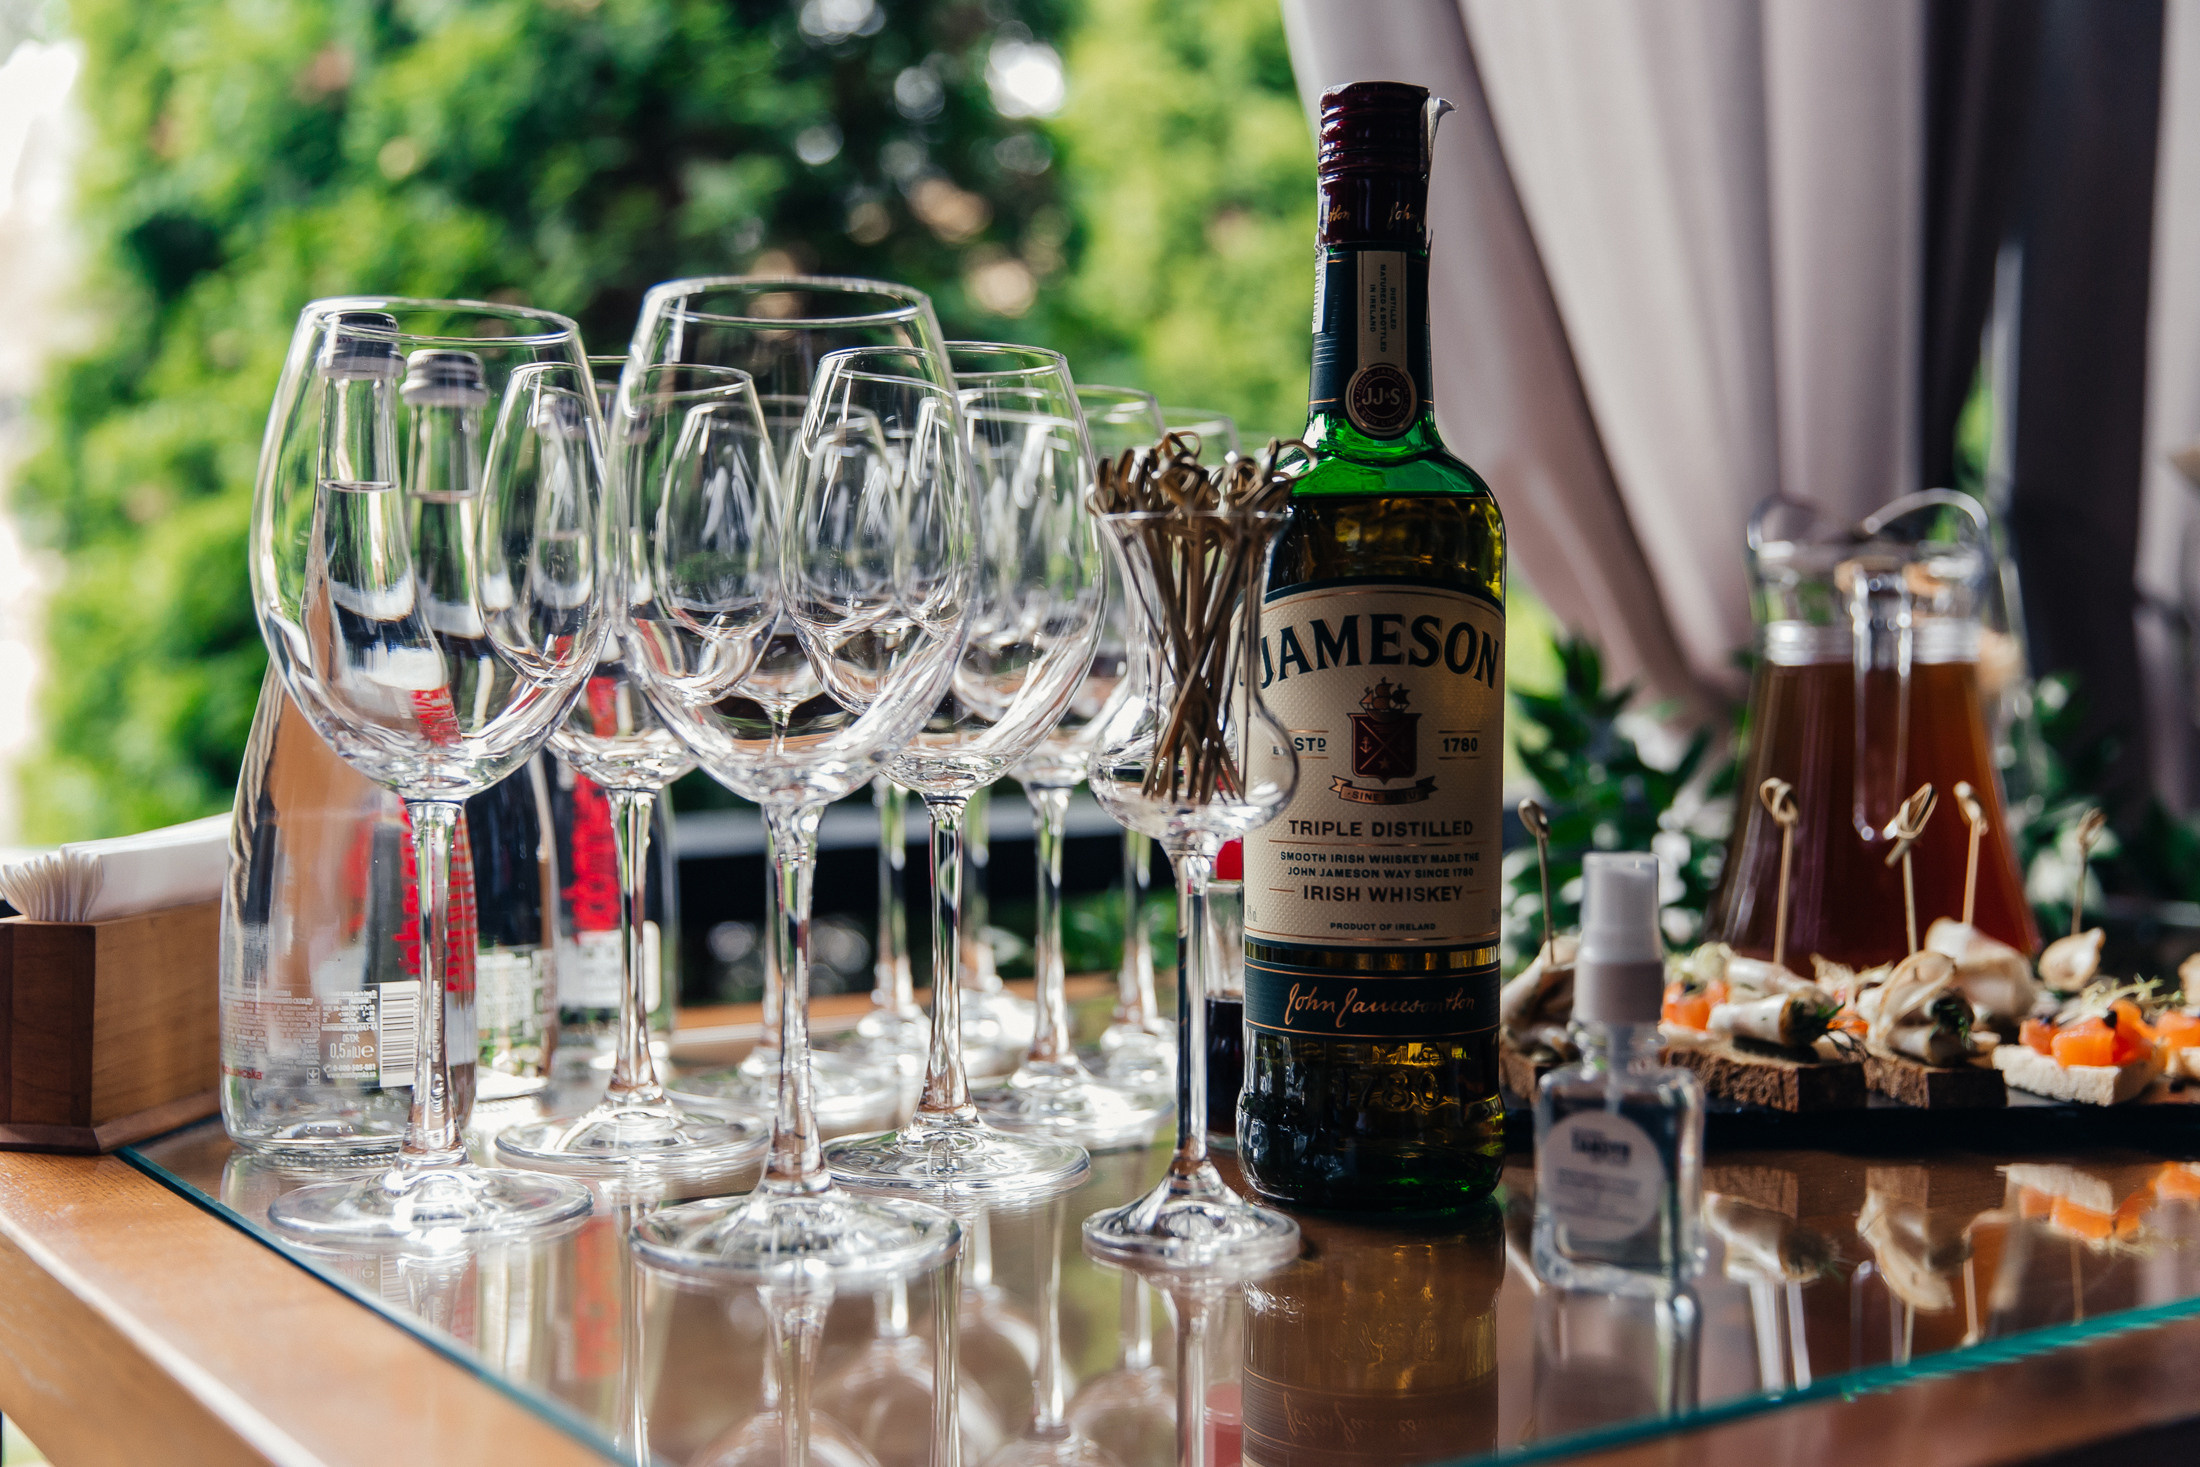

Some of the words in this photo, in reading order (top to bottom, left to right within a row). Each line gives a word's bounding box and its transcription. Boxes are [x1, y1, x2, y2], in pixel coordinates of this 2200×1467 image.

[1261, 613, 1500, 690] JAMESON
[1442, 737, 1479, 752] 1780
[1288, 820, 1363, 837] TRIPLE
[1371, 820, 1474, 838] DISTILLED
[1280, 851, 1327, 863] SMOOTH
[1330, 852, 1365, 864] IRISH
[1369, 853, 1427, 865] WHISKEY
[1430, 852, 1462, 863] MADE
[1464, 851, 1480, 862] THE
[1287, 866, 1317, 877] JOHN
[1319, 867, 1380, 879] JAMESON
[1383, 868, 1412, 879] WAY
[1415, 867, 1450, 878] SINCE
[1303, 884, 1360, 902] IRISH
[1368, 885, 1464, 903] WHISKEY
[1330, 921, 1376, 931] PRODUCT
[1379, 922, 1393, 931] OF
[1395, 922, 1436, 931] IRELAND
[1284, 982, 1336, 1026] John
